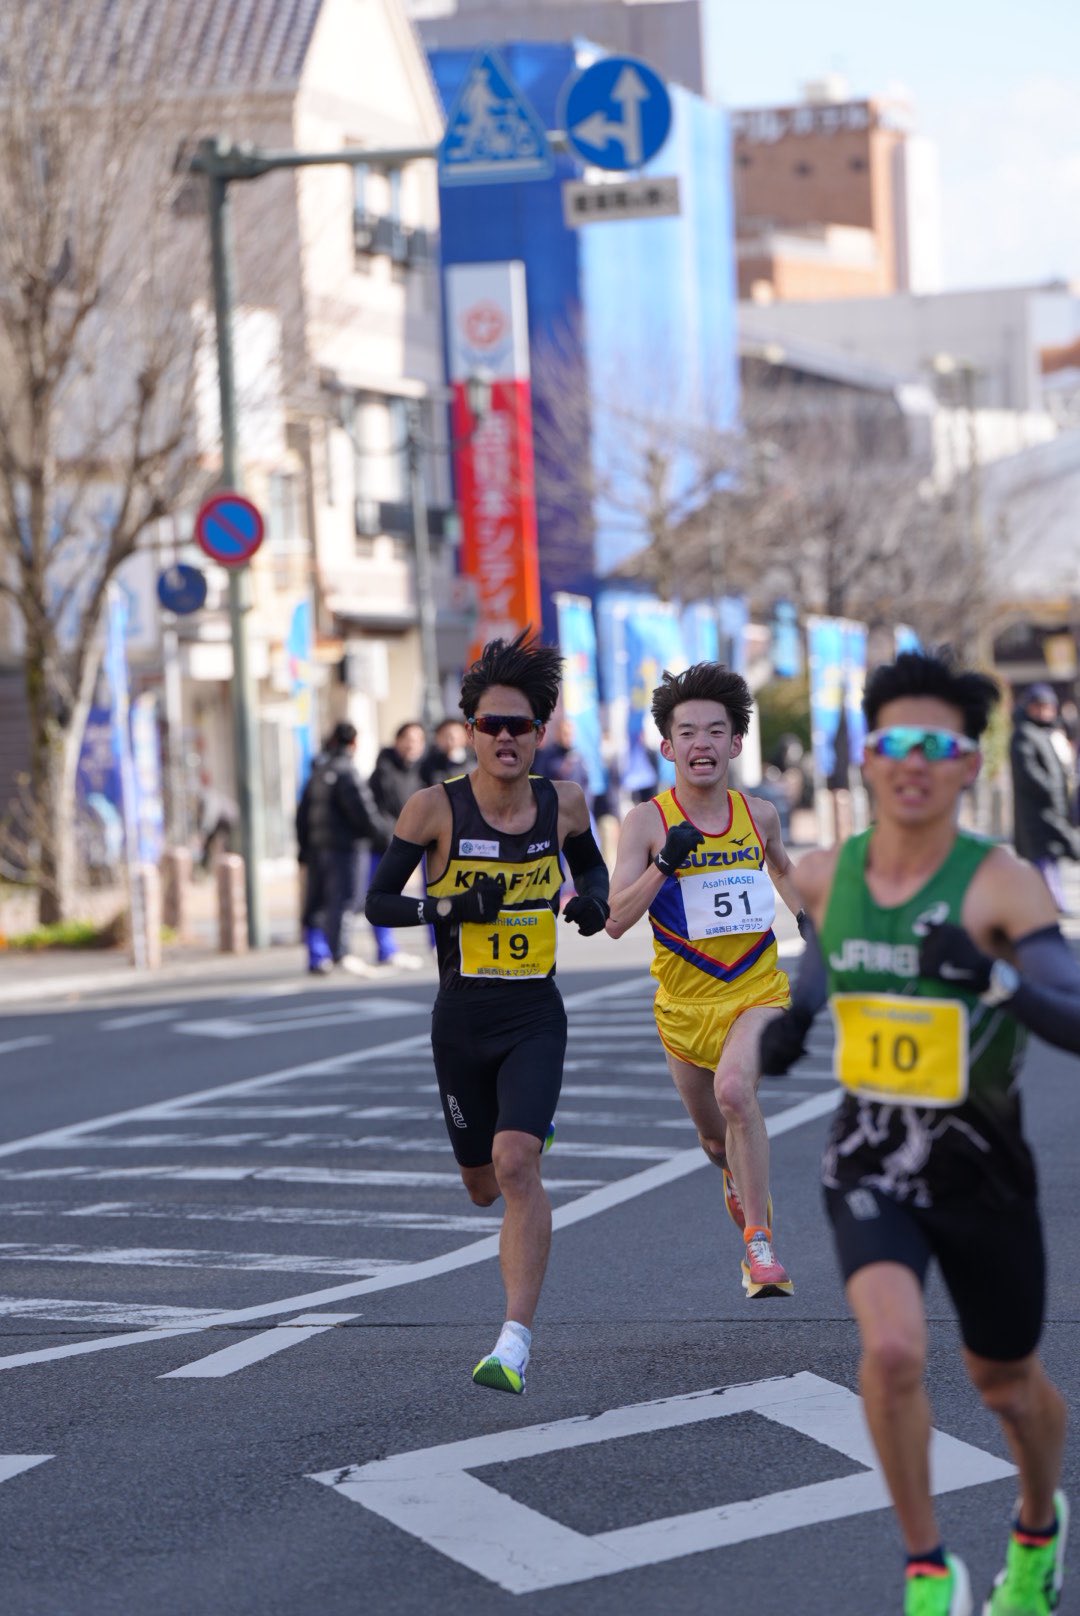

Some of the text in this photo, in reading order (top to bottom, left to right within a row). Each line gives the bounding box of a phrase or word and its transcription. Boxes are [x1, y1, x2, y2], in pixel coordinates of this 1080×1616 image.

[526, 840, 551, 854] 2XU
[679, 847, 760, 869] SUZUKI
[702, 876, 755, 890] AsahiKASEI
[714, 891, 752, 918] 51
[488, 933, 529, 960] 19
[868, 1032, 921, 1073] 10
[446, 1094, 468, 1129] 2XU
